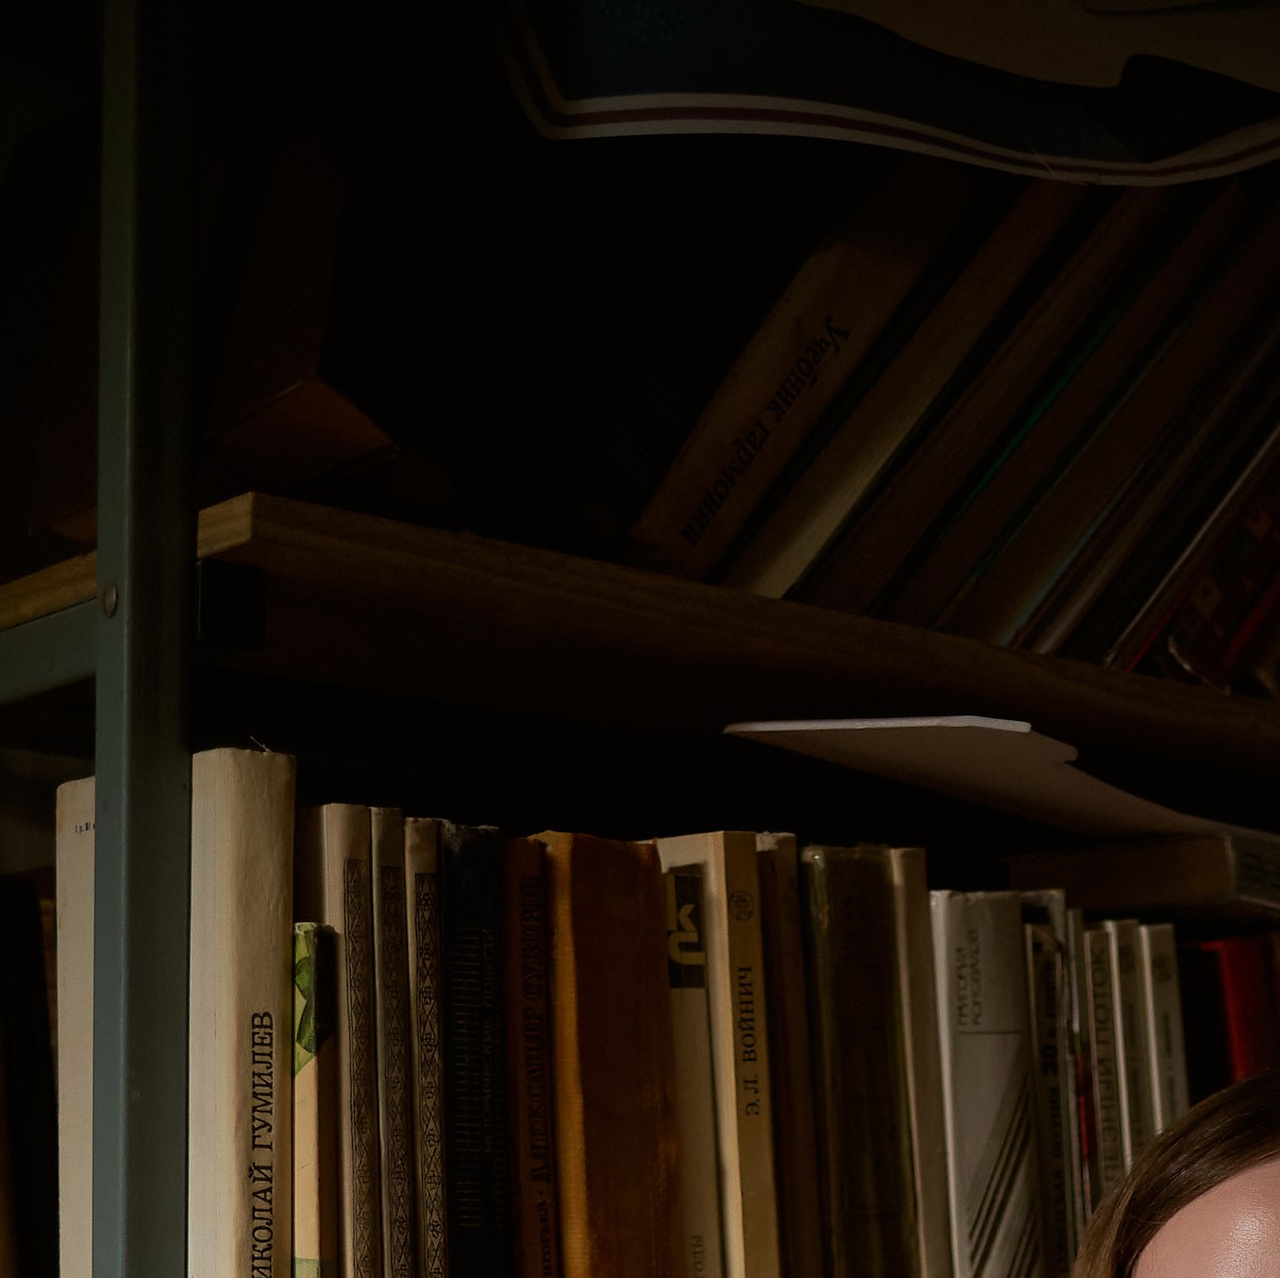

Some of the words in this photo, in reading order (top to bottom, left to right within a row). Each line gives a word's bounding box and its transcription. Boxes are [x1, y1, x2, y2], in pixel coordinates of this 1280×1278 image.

[767, 315, 851, 420] Учебник
[680, 414, 790, 548] гармонии
[482, 926, 495, 1009] ПОВЕСТИ
[737, 965, 758, 1062] ВОЙНИЧ
[1090, 945, 1111, 1044] ПОТОК
[251, 1010, 276, 1153] ГУМИЛЕВ
[526, 1008, 551, 1188] АЛЕКСАНДР
